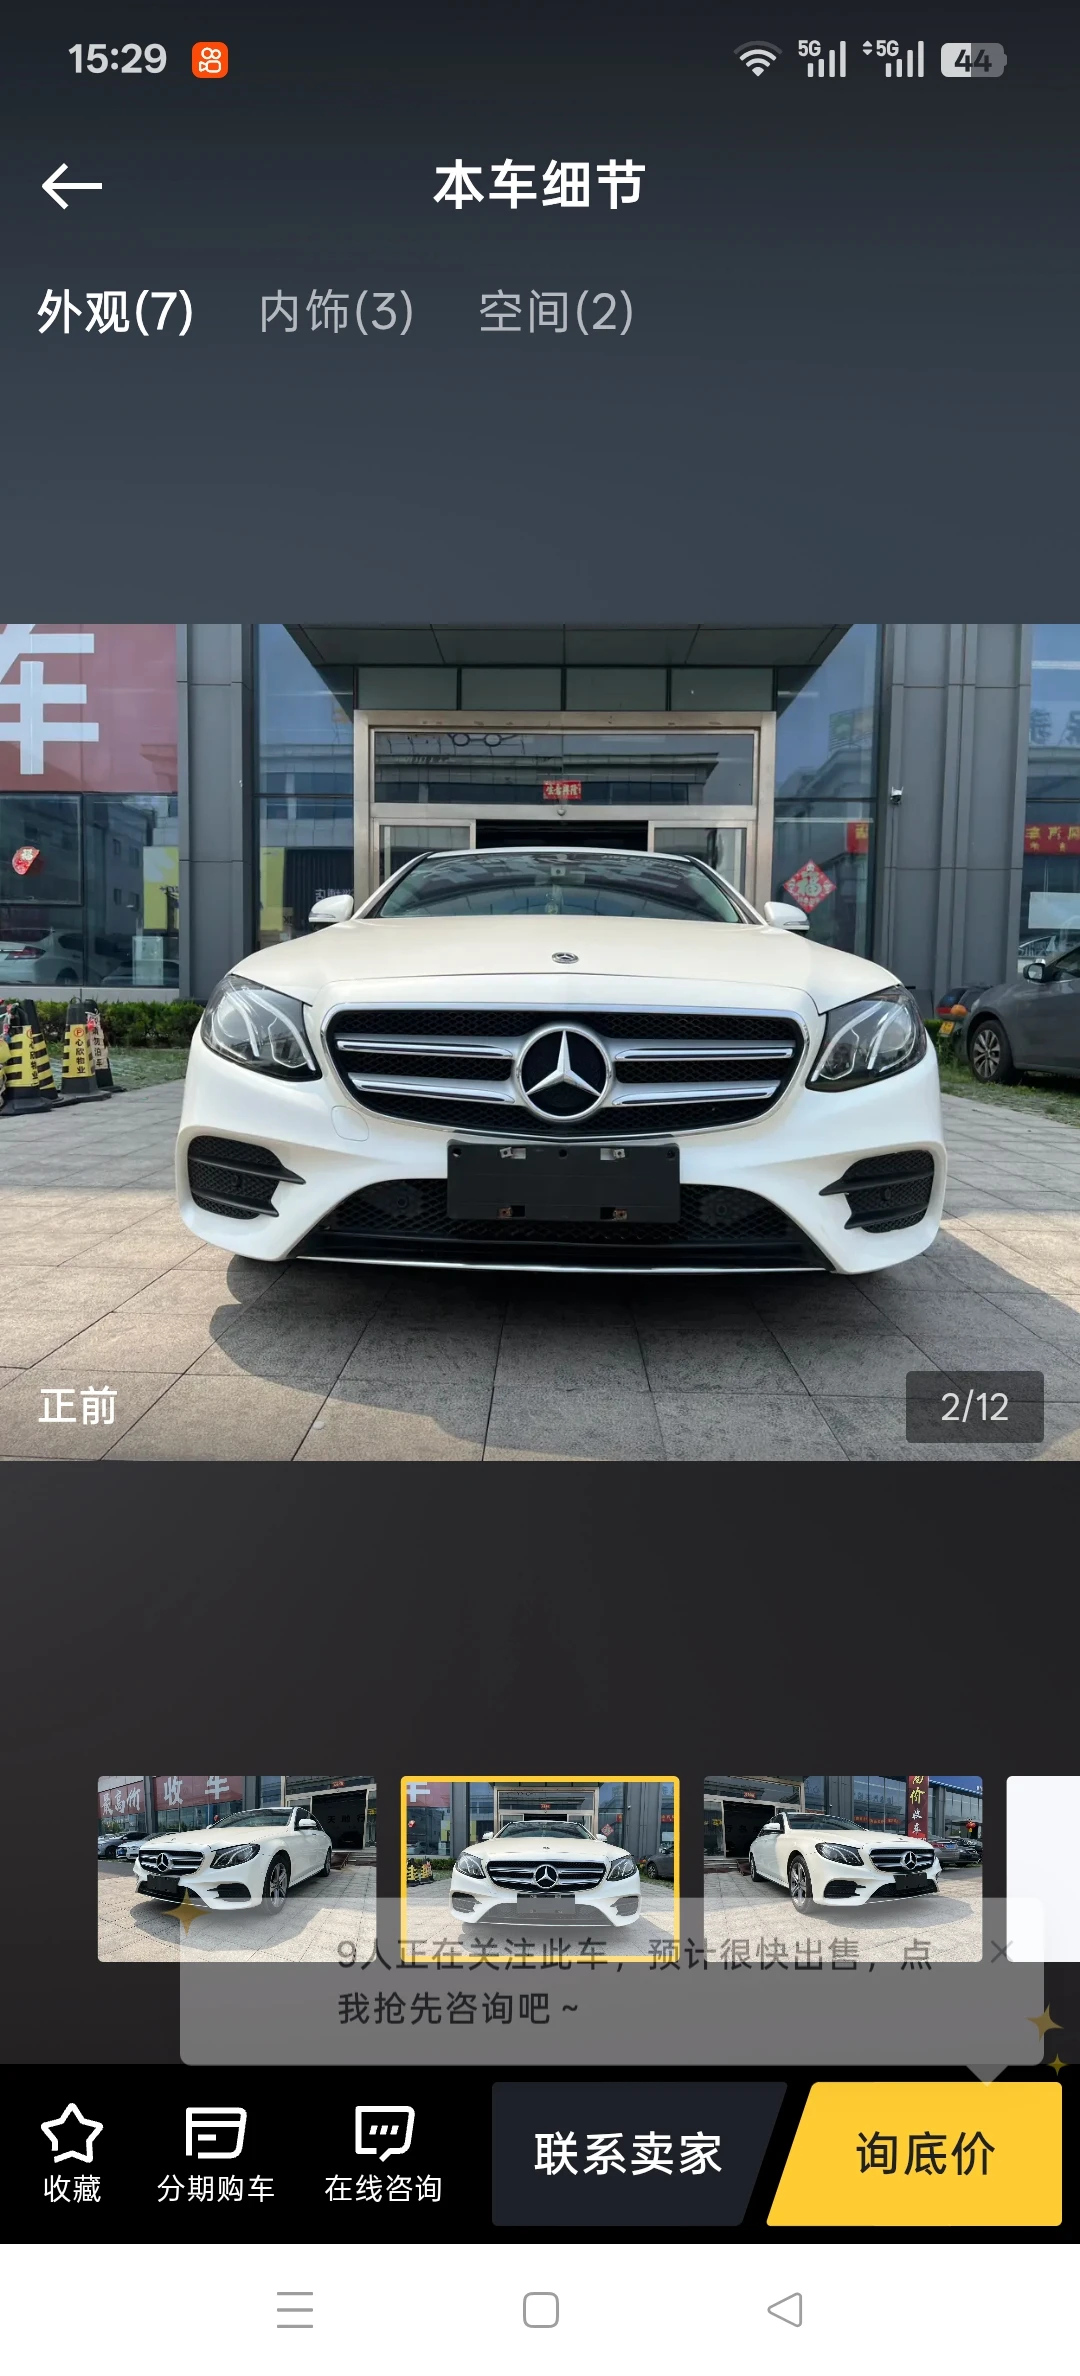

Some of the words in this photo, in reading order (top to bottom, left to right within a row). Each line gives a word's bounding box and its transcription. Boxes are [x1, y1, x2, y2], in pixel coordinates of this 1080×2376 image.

[69, 43, 167, 73] 15:29
[798, 40, 821, 57] 5G
[876, 40, 899, 57] 5G
[954, 49, 993, 72] 44
[433, 158, 645, 209] 本车细节
[37, 288, 193, 337] 外观(7)
[261, 288, 413, 337] 内饰(3)
[479, 288, 634, 337] 空间(2)
[797, 871, 822, 897] 福
[533, 2130, 723, 2176] 联系卖家
[855, 2130, 996, 2176] 询底价
[44, 2173, 102, 2203] 收藏
[157, 2173, 275, 2203] 分期购车
[324, 2173, 442, 2203] 在线咨询
